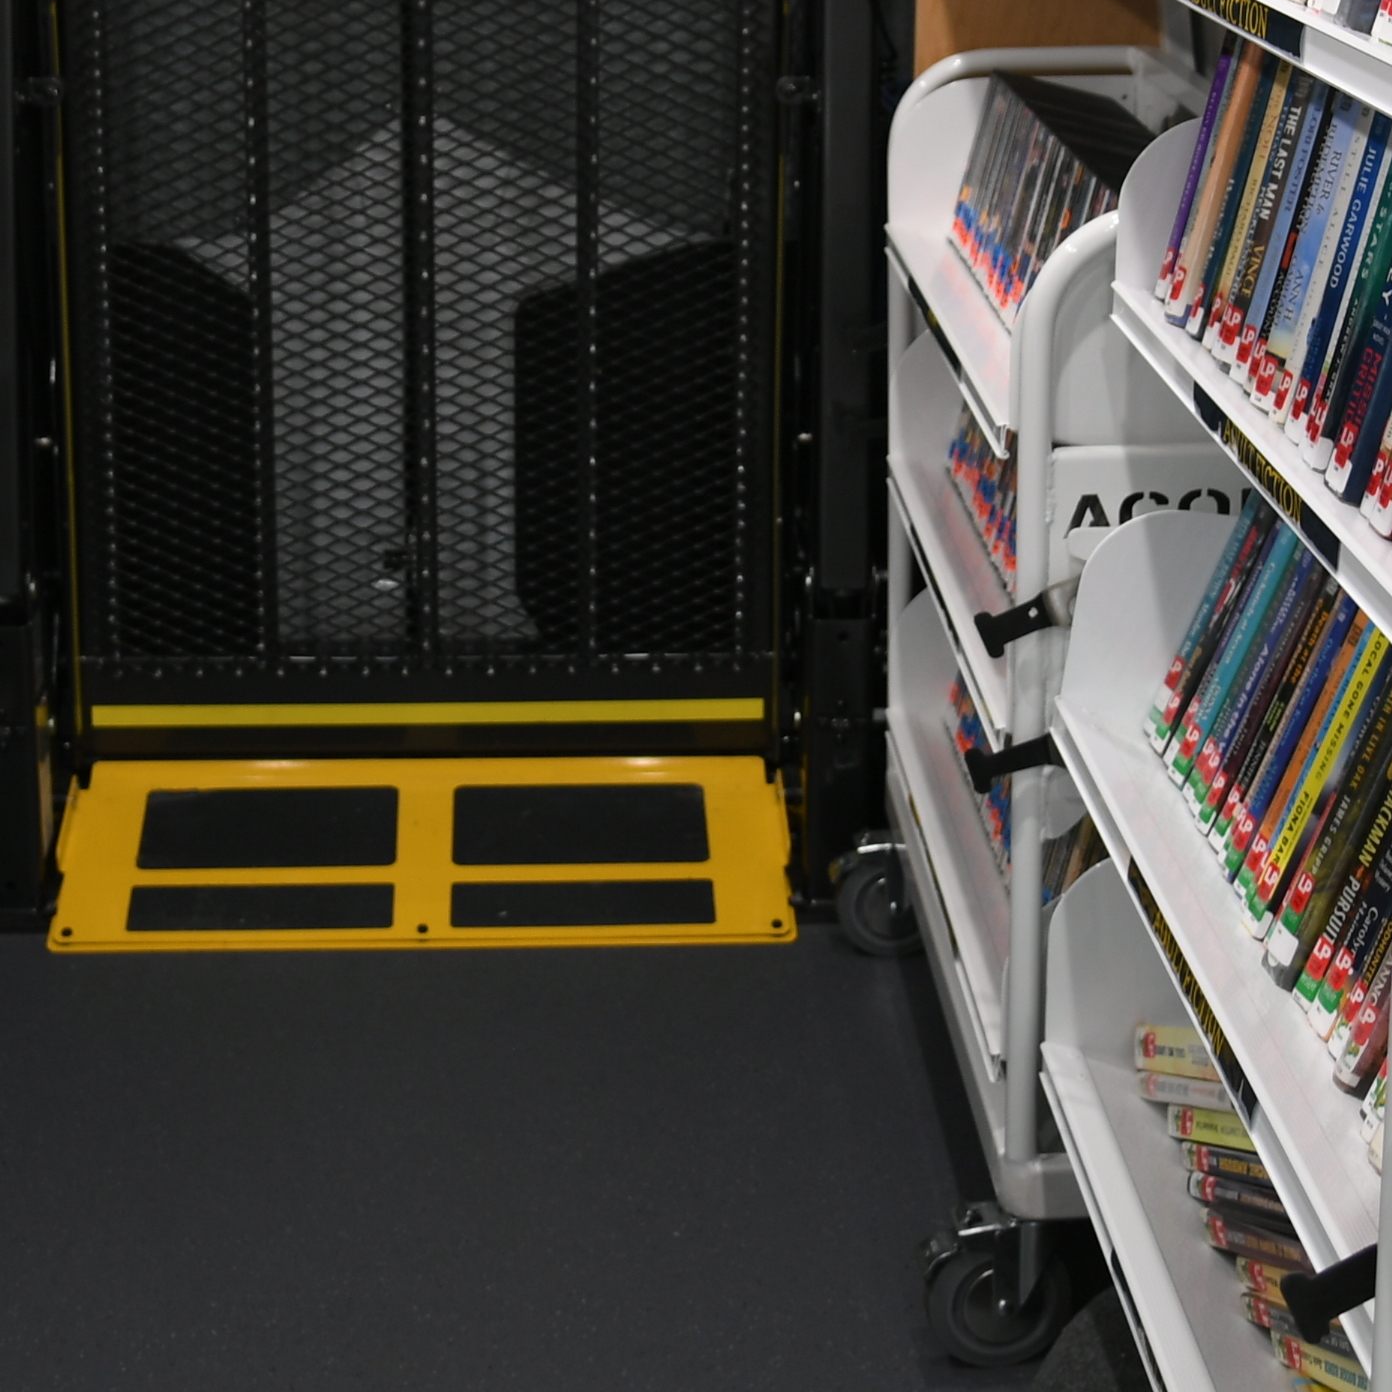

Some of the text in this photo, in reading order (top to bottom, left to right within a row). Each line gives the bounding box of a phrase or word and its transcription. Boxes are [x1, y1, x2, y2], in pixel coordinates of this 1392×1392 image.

[1259, 107, 1302, 221] THE LAST MAN
[1329, 147, 1377, 289] JULIE GARWOOD
[1360, 207, 1388, 280] STARS
[1242, 244, 1265, 298] VINCE
[1260, 359, 1275, 377] LP
[1340, 428, 1354, 447] LP
[1255, 453, 1303, 522] FICTION
[1314, 633, 1387, 780] LOCAL GONE MISSING
[1288, 790, 1311, 834] FIONA
[1324, 874, 1361, 944] PURSUIT
